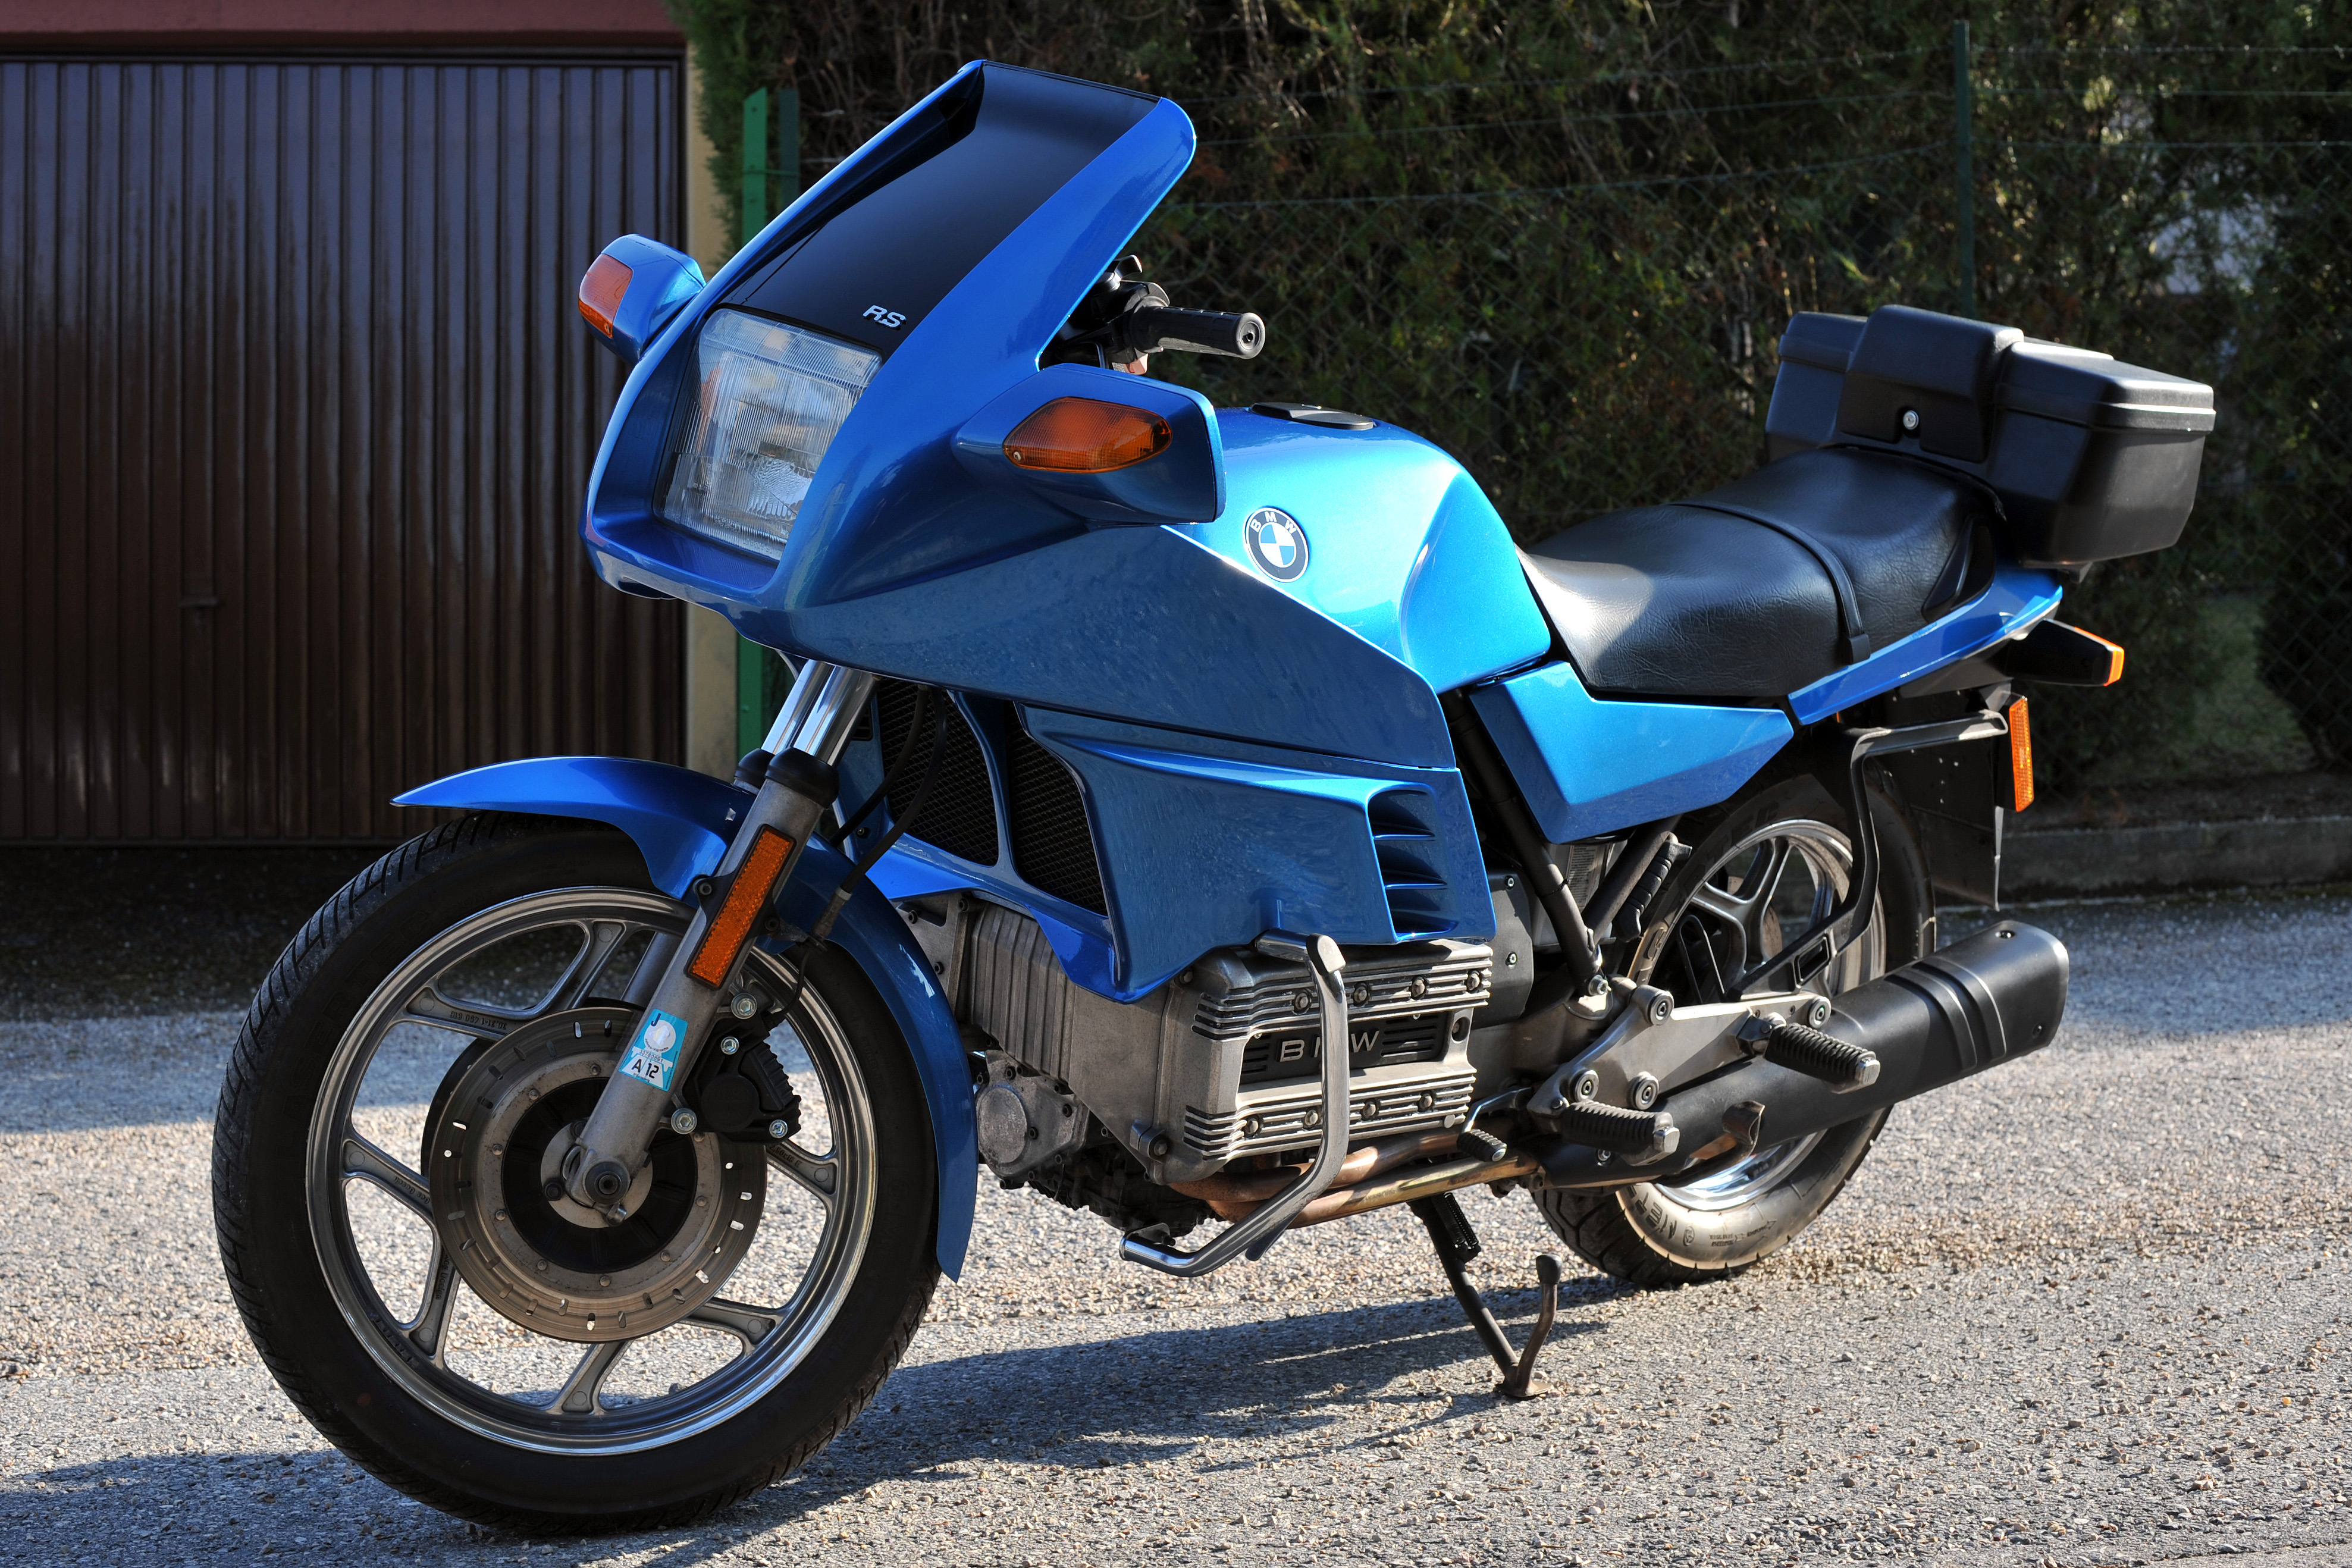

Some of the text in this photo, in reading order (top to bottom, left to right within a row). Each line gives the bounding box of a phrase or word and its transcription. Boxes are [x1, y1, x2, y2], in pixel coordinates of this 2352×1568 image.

[863, 304, 907, 329] RS
[1250, 511, 1297, 534] BMW
[650, 1012, 661, 1027] J
[1277, 1030, 1379, 1063] BW
[631, 1058, 642, 1073] A
[645, 1062, 660, 1079] 12
